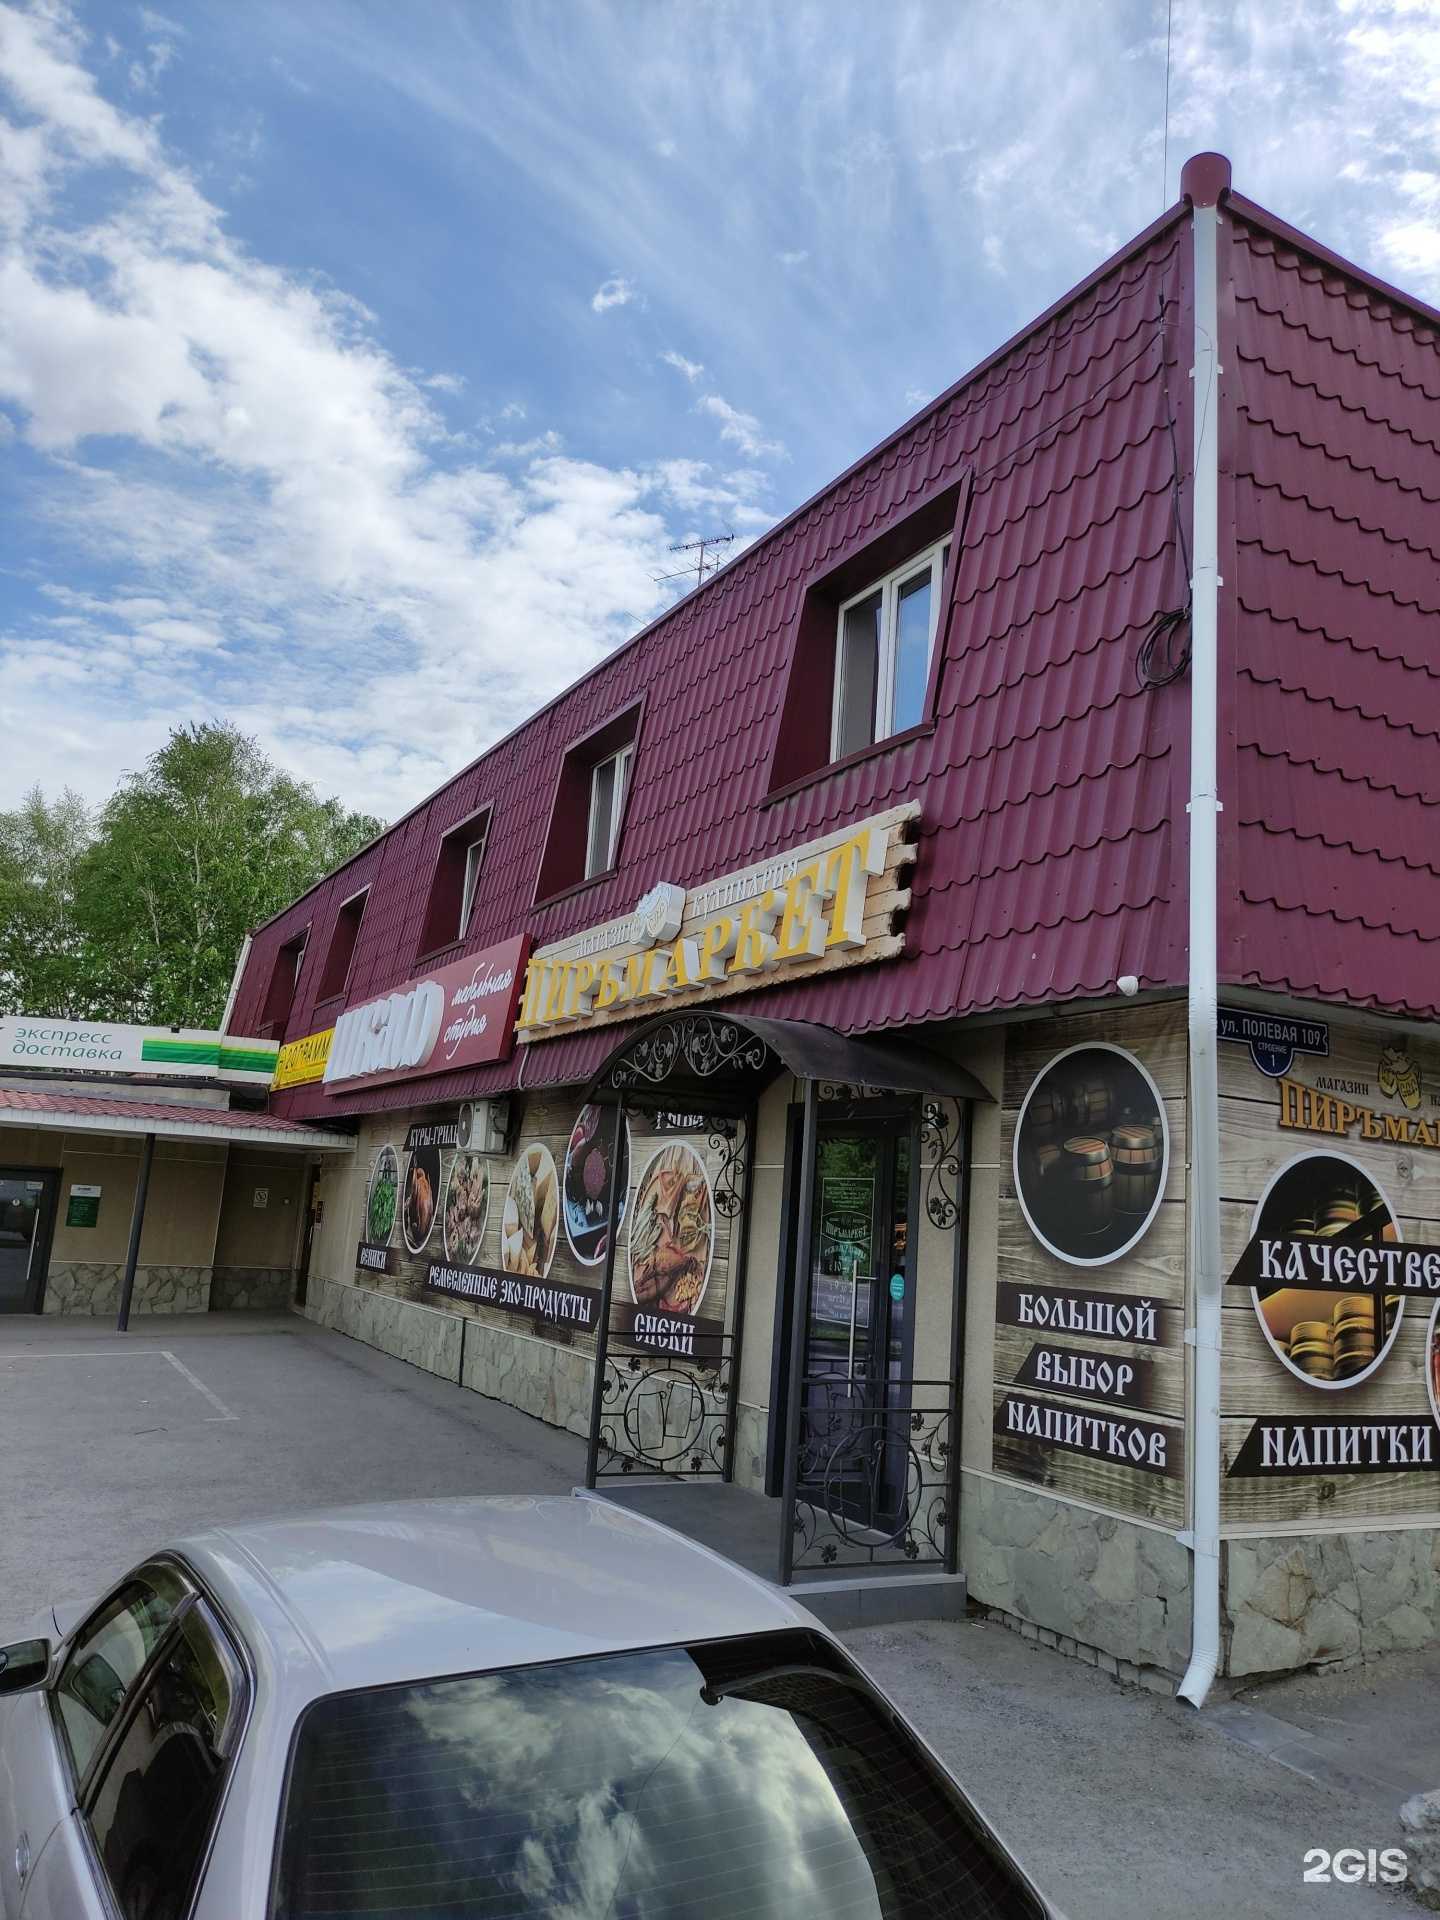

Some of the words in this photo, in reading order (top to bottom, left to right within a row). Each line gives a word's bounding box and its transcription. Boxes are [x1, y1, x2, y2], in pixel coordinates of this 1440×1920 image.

[515, 826, 889, 1031] ПИРЪМАРКЕТ
[451, 962, 513, 1007] мебельная
[12, 1039, 122, 1061] доставка
[15, 1027, 113, 1045] экспресс
[443, 1004, 488, 1061] студия
[1221, 1019, 1239, 1035] ул.
[1242, 1019, 1297, 1042] ПОЛЕВАЯ
[1302, 1028, 1320, 1046] 109
[1271, 1054, 1276, 1068] 1
[1316, 1076, 1369, 1096] МАГАЗИН
[429, 1265, 498, 1299] РЕМЕСЛЕННЫЕ
[500, 1279, 592, 1323] ЭКО-ПРОДУКТЫ
[634, 1313, 696, 1355] СНЕКИ
[1018, 1293, 1158, 1341] БОЛЬШОЙ
[1035, 1351, 1134, 1396] ВЫБОР
[1006, 1400, 1167, 1467] НАПИТКОВ
[1260, 1426, 1433, 1467] НАПИТКИ
